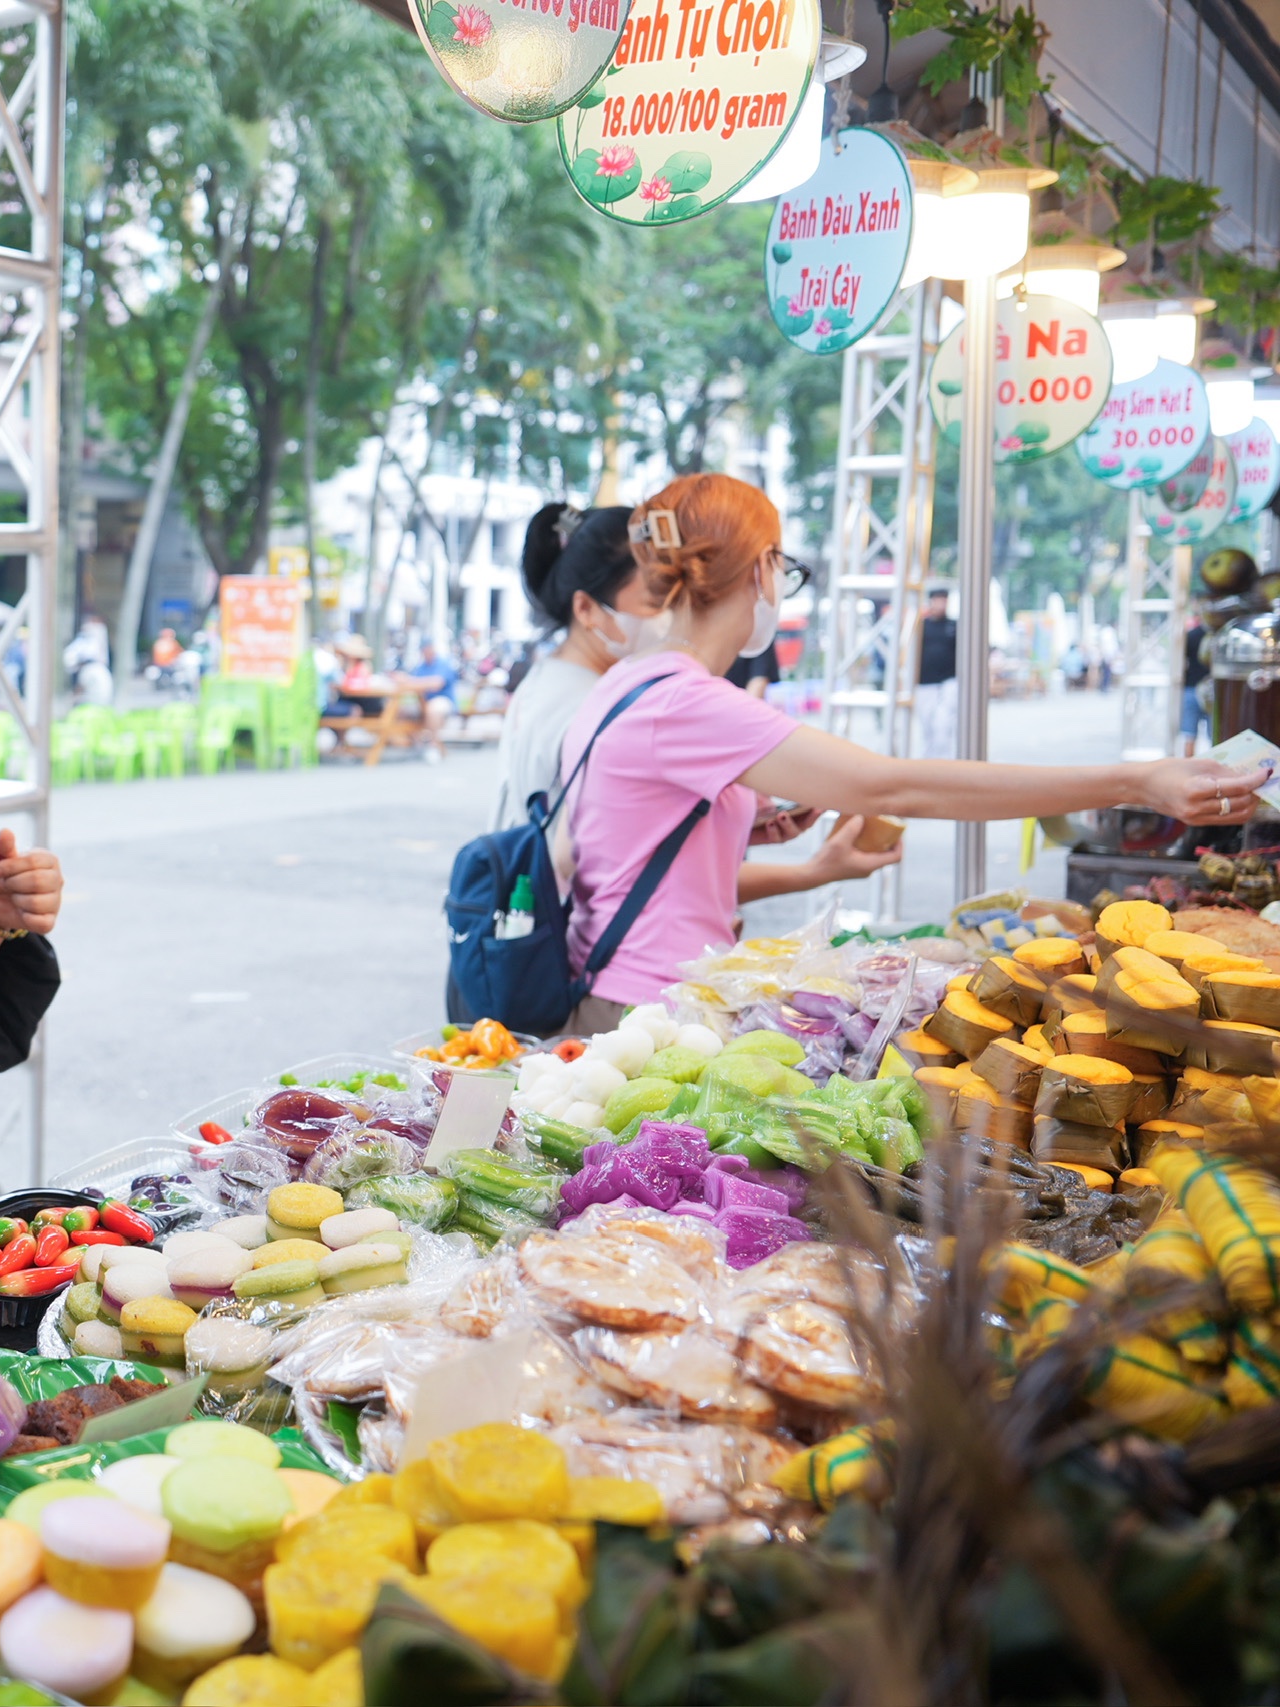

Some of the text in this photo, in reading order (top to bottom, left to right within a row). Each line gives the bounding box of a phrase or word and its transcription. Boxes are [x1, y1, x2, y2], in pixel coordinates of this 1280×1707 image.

[675, 0, 714, 72] Tự
[717, 0, 795, 67] Chọn
[602, 87, 787, 139] 18.000/100 gram
[780, 187, 900, 244] Bánh Đậu Xanh
[800, 263, 861, 315] Trái Cây
[1026, 319, 1088, 358] Na
[997, 375, 1092, 405] 0.000
[1112, 425, 1194, 449] 30.000
